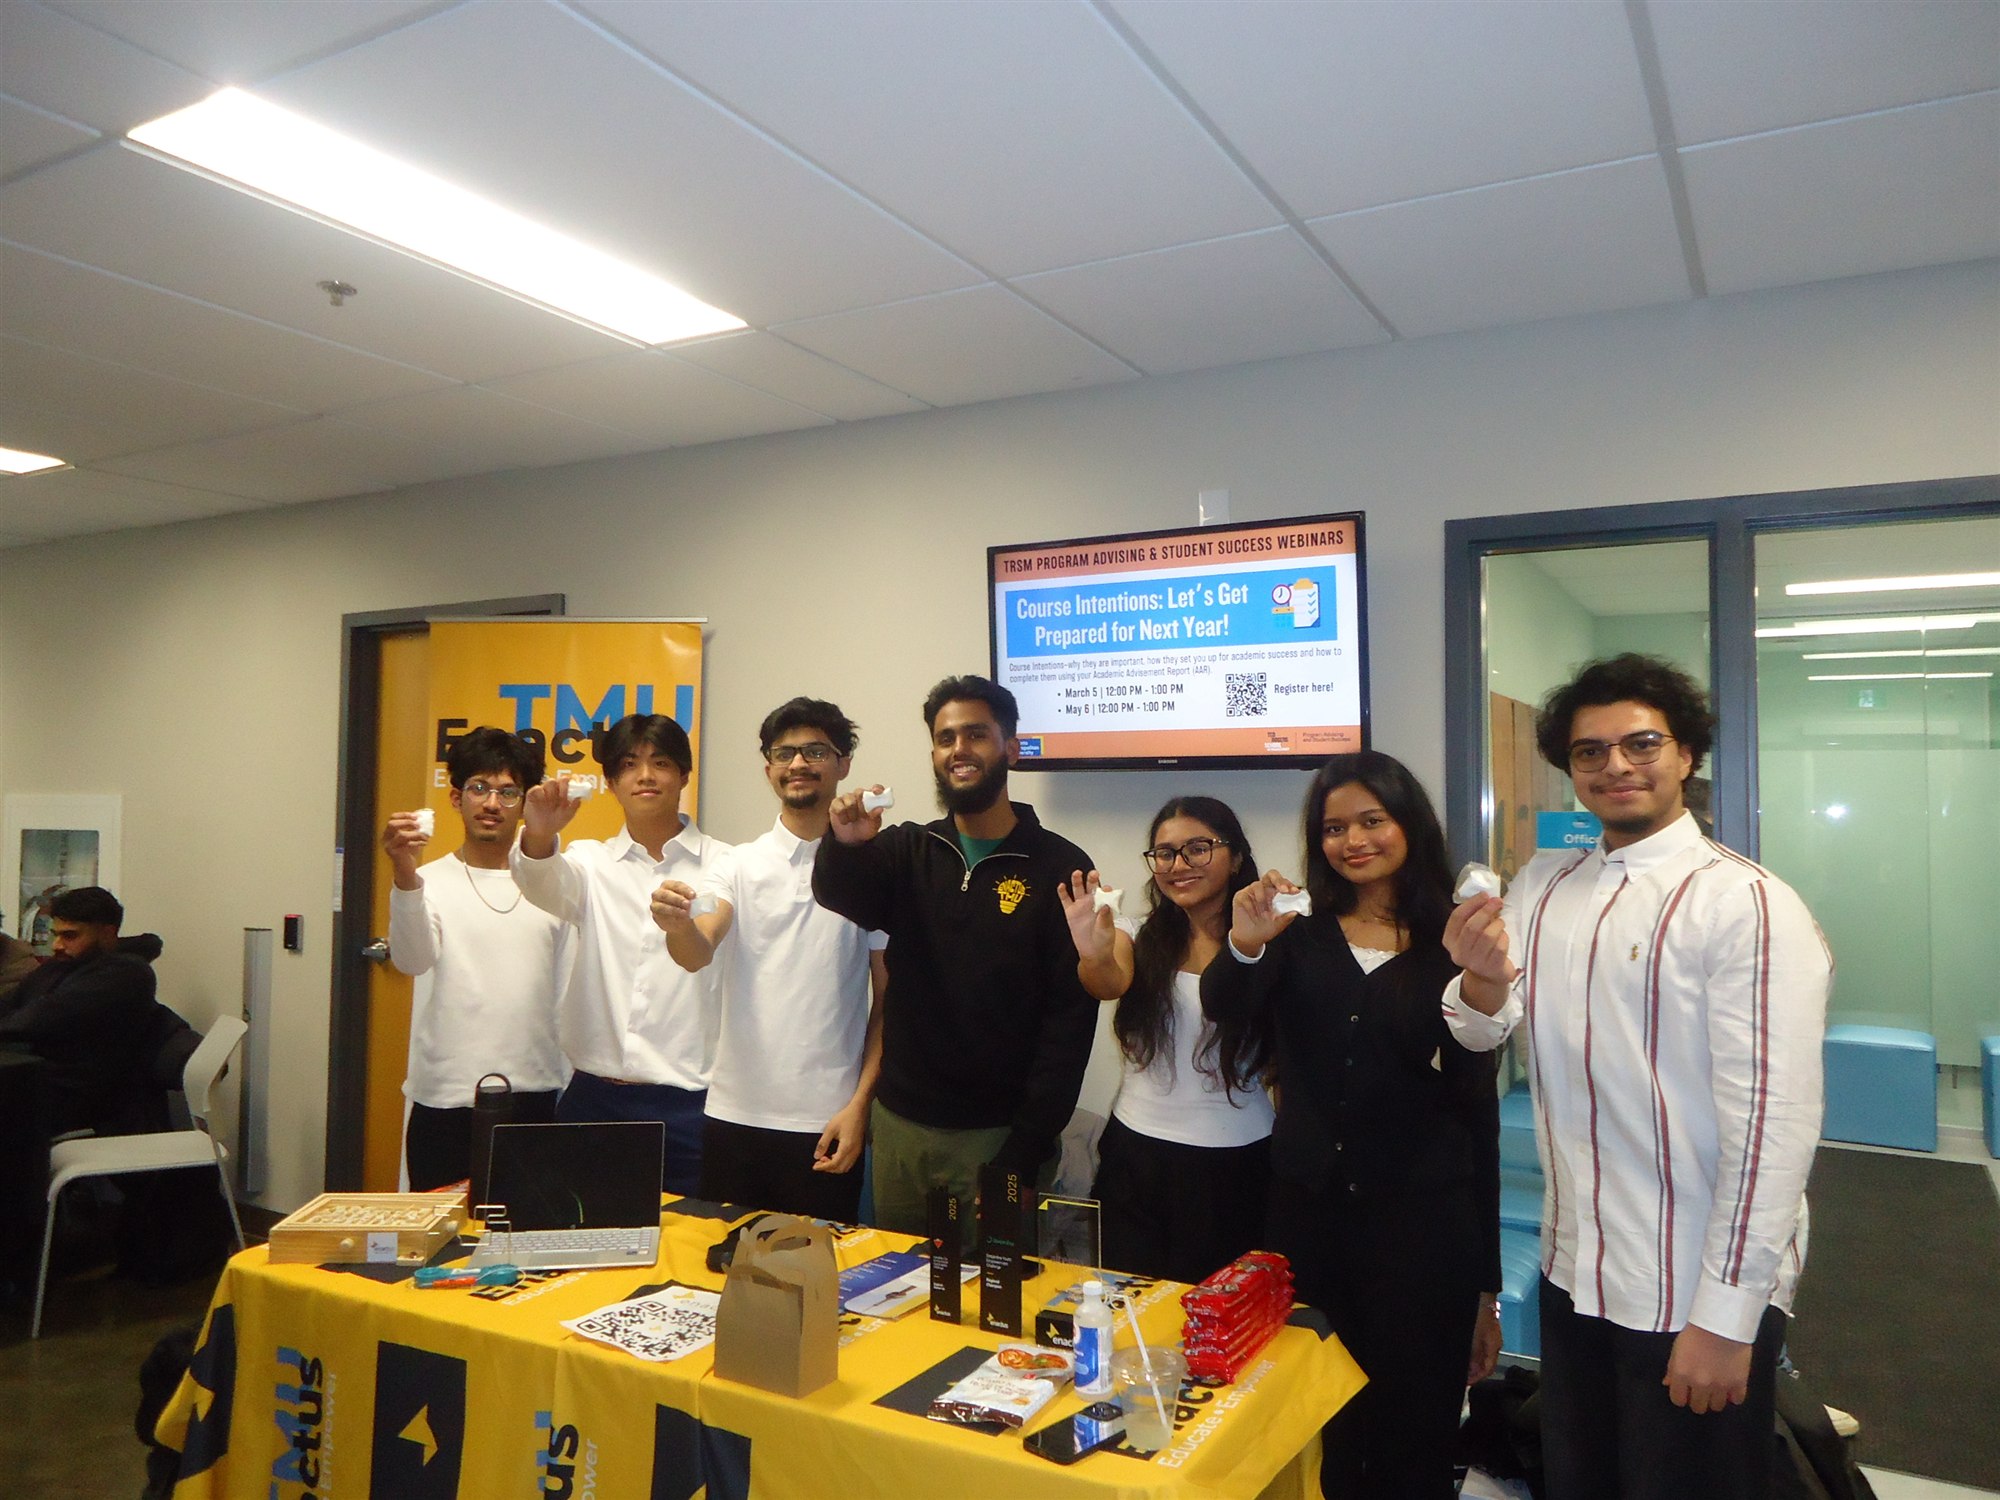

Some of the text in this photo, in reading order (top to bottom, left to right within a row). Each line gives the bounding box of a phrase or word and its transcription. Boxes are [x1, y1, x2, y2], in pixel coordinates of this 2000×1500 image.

[1004, 530, 1345, 573] TRSM PROGRAM ADVISING & STUDENT SUCCESS WEBINARS
[1016, 582, 1249, 620] Course Intentions: Let's Get
[1035, 614, 1230, 649] Prepared for Next Year!
[1009, 662, 1031, 672] Course
[1082, 659, 1097, 669] they
[1099, 659, 1110, 668] are
[1147, 655, 1161, 665] how
[1163, 655, 1178, 665] they
[1180, 654, 1191, 664] set
[1193, 654, 1206, 665] you
[1208, 654, 1217, 664] up
[1219, 652, 1229, 661] for
[1231, 650, 1266, 661] academic
[1268, 649, 1298, 659] success
[1300, 647, 1314, 657] and
[1316, 647, 1332, 657] how
[1333, 647, 1343, 656] to
[1009, 673, 1039, 684] complete
[1040, 672, 1057, 682] them
[1058, 671, 1076, 682] using
[1077, 671, 1092, 681] your
[1093, 669, 1124, 680] Academic
[1126, 667, 1165, 678] Advisement
[1167, 665, 1190, 677] Report
[1065, 687, 1091, 698] March
[1092, 687, 1098, 697] 5
[1106, 685, 1127, 697] 12:00
[1129, 684, 1142, 696] PM
[1151, 684, 1168, 695] 1:00
[1170, 683, 1184, 694] PM
[1274, 682, 1334, 696] Register here!
[499, 684, 694, 746] TMU
[1065, 704, 1083, 717] May
[1084, 703, 1090, 714] 6
[1098, 702, 1119, 714] 12:00
[1121, 701, 1134, 713] PM
[1143, 701, 1159, 712] 1:00
[1161, 701, 1175, 711] PM
[1563, 833, 1596, 844] Offic
[998, 890, 1023, 903] TMU
[1007, 1173, 1018, 1203] 2025
[948, 1196, 958, 1221] 2025
[1052, 1336, 1074, 1347] enac
[1157, 1415, 1223, 1469] Educate
[1215, 1359, 1278, 1410] Empower
[319, 1371, 337, 1490] Empower
